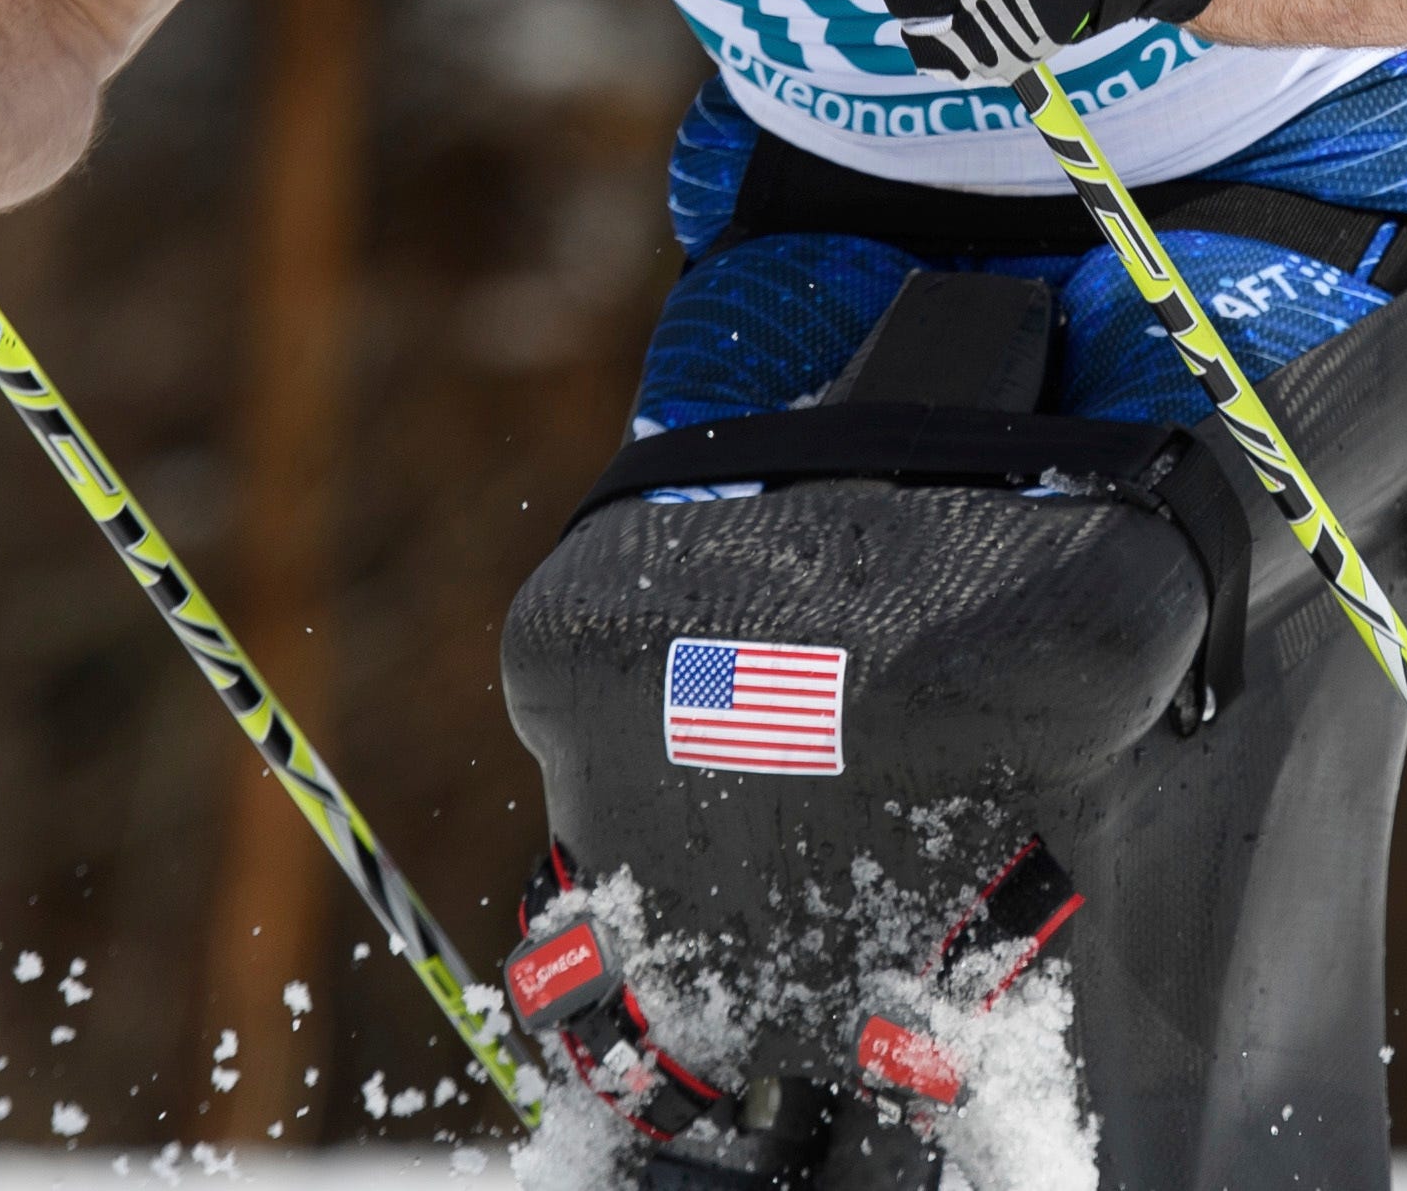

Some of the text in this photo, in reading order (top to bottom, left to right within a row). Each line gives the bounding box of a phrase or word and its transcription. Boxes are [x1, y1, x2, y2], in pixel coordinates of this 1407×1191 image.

[720, 37, 1142, 138] PyeongChng
[1211, 263, 1298, 320] AFT
[535, 944, 592, 984] OMEGA
